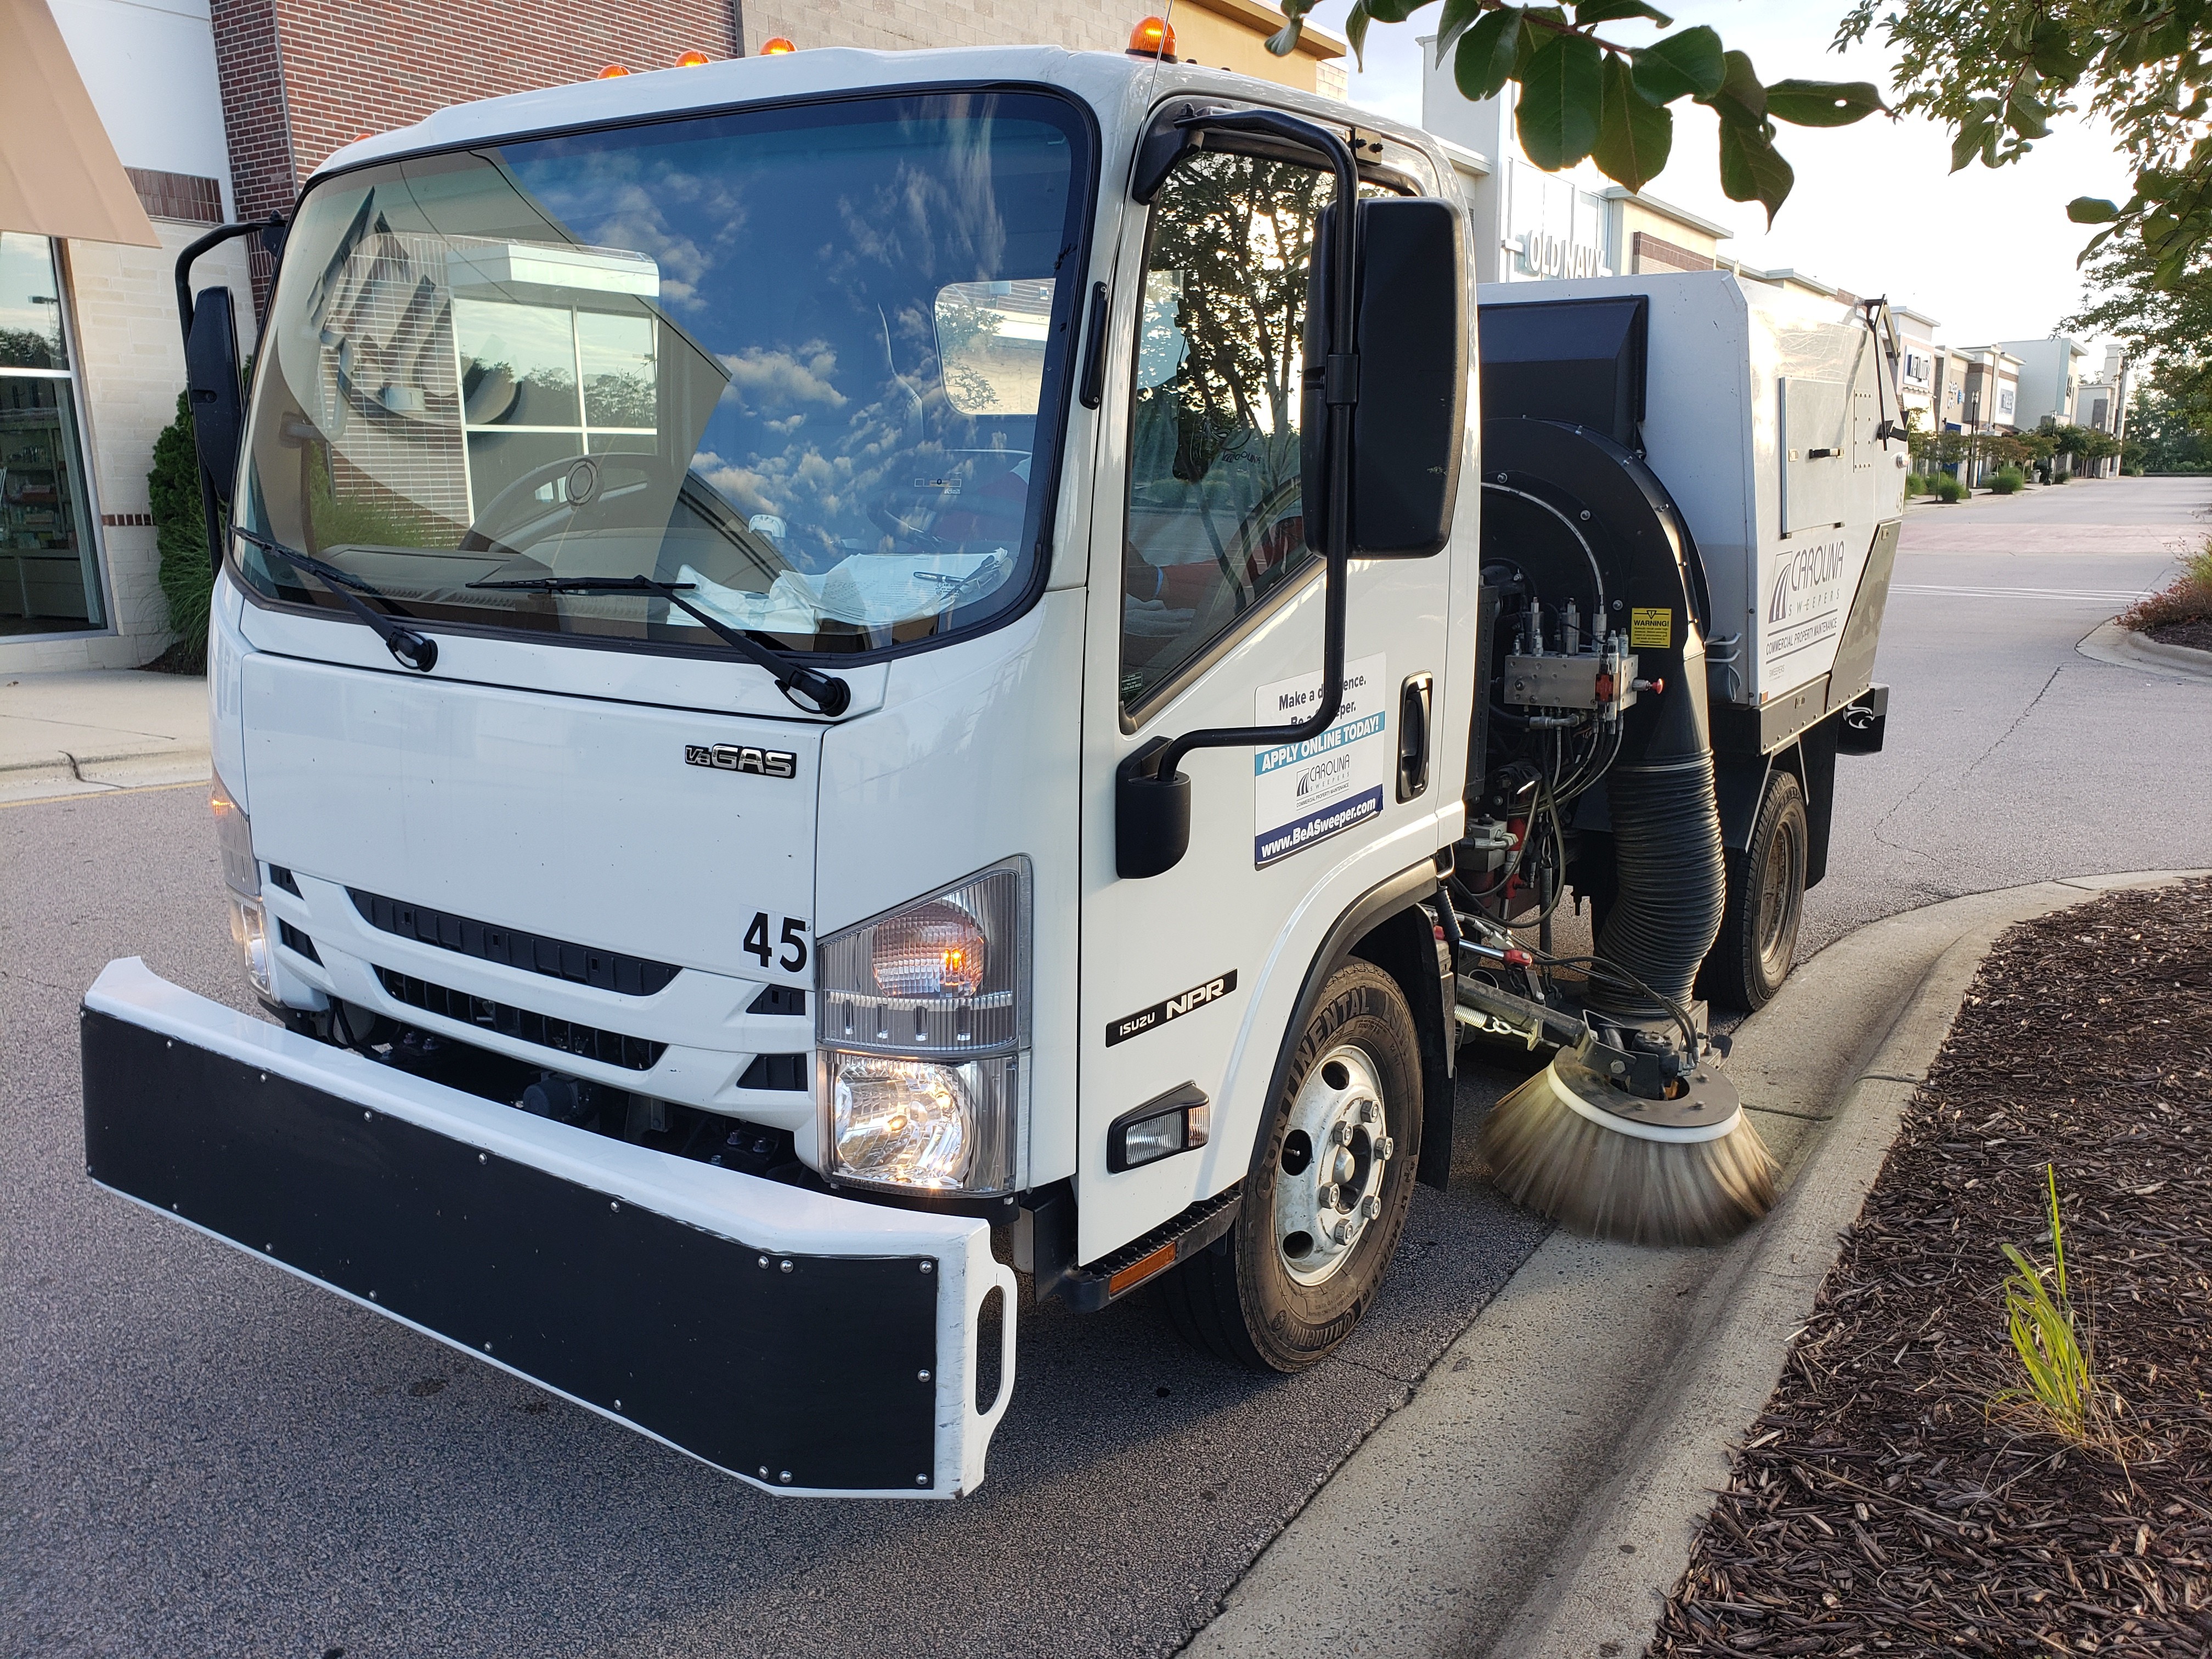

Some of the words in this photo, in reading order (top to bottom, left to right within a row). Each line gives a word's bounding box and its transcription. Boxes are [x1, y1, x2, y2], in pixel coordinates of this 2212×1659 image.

[1527, 230, 1560, 276] OLD
[1564, 239, 1605, 279] NAVY
[1791, 540, 1844, 591] CAROLINA
[1788, 589, 1839, 617] SWEEPERS
[1766, 635, 1793, 656] COMMERCIAL
[1794, 627, 1814, 645] PROPERTY
[1814, 617, 1837, 636] MAINTENANCE
[1279, 691, 1306, 711] Make
[1310, 690, 1314, 702] a
[1318, 675, 1366, 699] dence.
[712, 745, 792, 777] GAS
[1262, 746, 1300, 771] APPLY
[1301, 731, 1341, 758] ONLINE
[1343, 715, 1379, 741] TODAY!
[1310, 754, 1350, 782] CAROLINA
[1310, 771, 1350, 791] SWEEPERS
[1296, 797, 1315, 808] COMMERCIAL
[1316, 791, 1330, 800] PROPERTY
[1330, 782, 1349, 794] MAINTENANCE
[1261, 797, 1376, 857] www.BeASweeper.com
[743, 912, 808, 973] 45
[1120, 1012, 1155, 1036] ISUZU
[1166, 978, 1224, 1020] NPR
